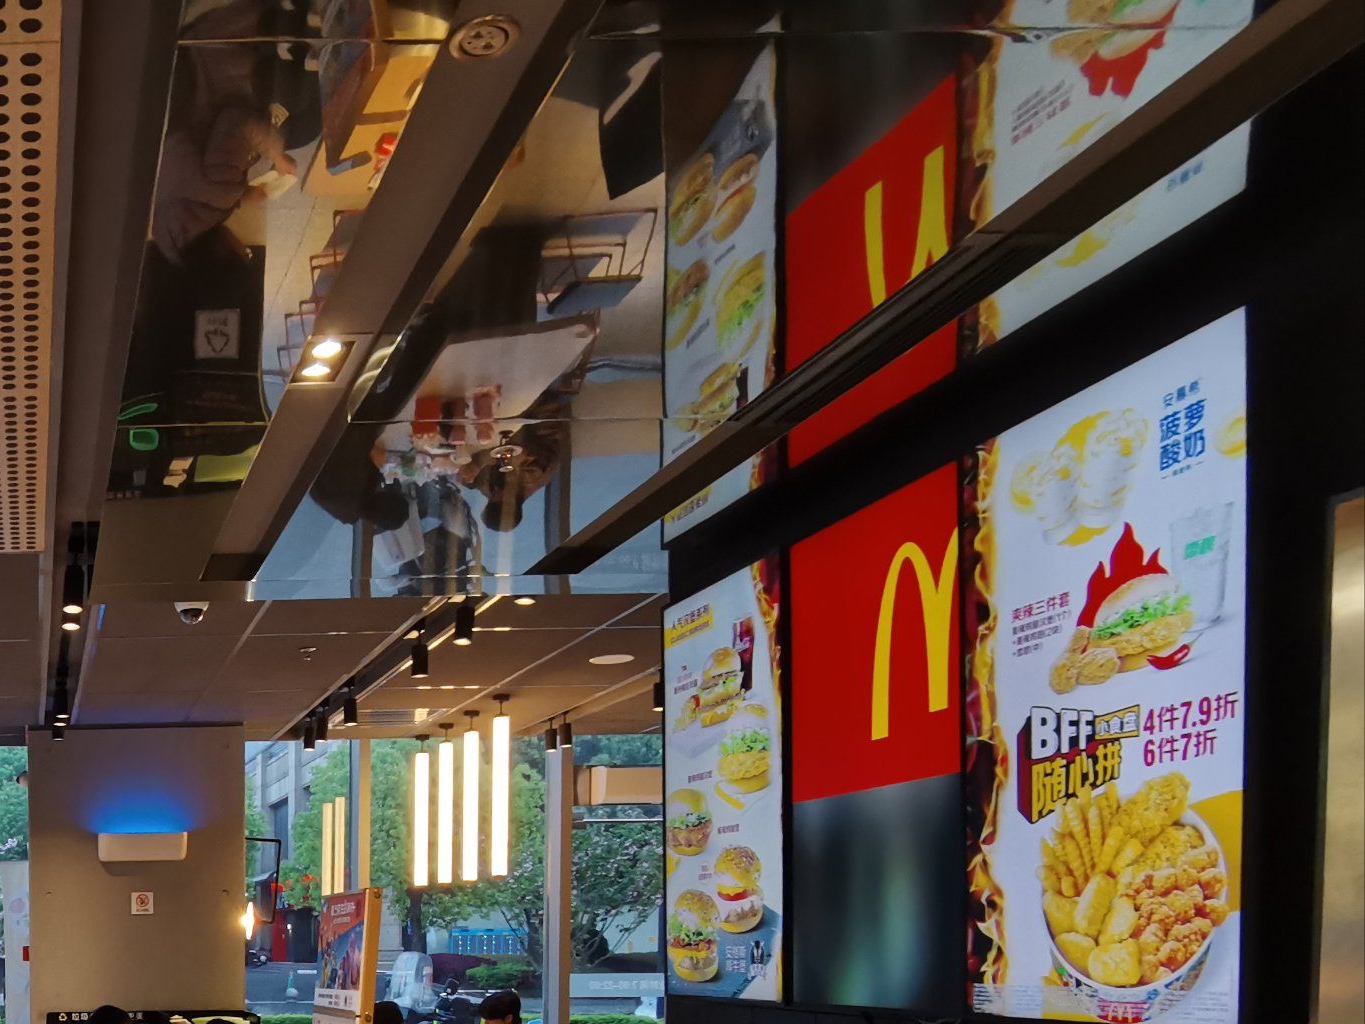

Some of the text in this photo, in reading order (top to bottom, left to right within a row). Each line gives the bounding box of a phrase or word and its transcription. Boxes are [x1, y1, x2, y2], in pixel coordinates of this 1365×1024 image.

[1160, 398, 1207, 443] 菠萝
[1160, 428, 1206, 472] 酸奶
[1030, 706, 1095, 760] BFF
[1143, 691, 1239, 736] 4件7.9折
[1143, 729, 1217, 767] 6件7折
[1031, 741, 1123, 823] 随心拼
